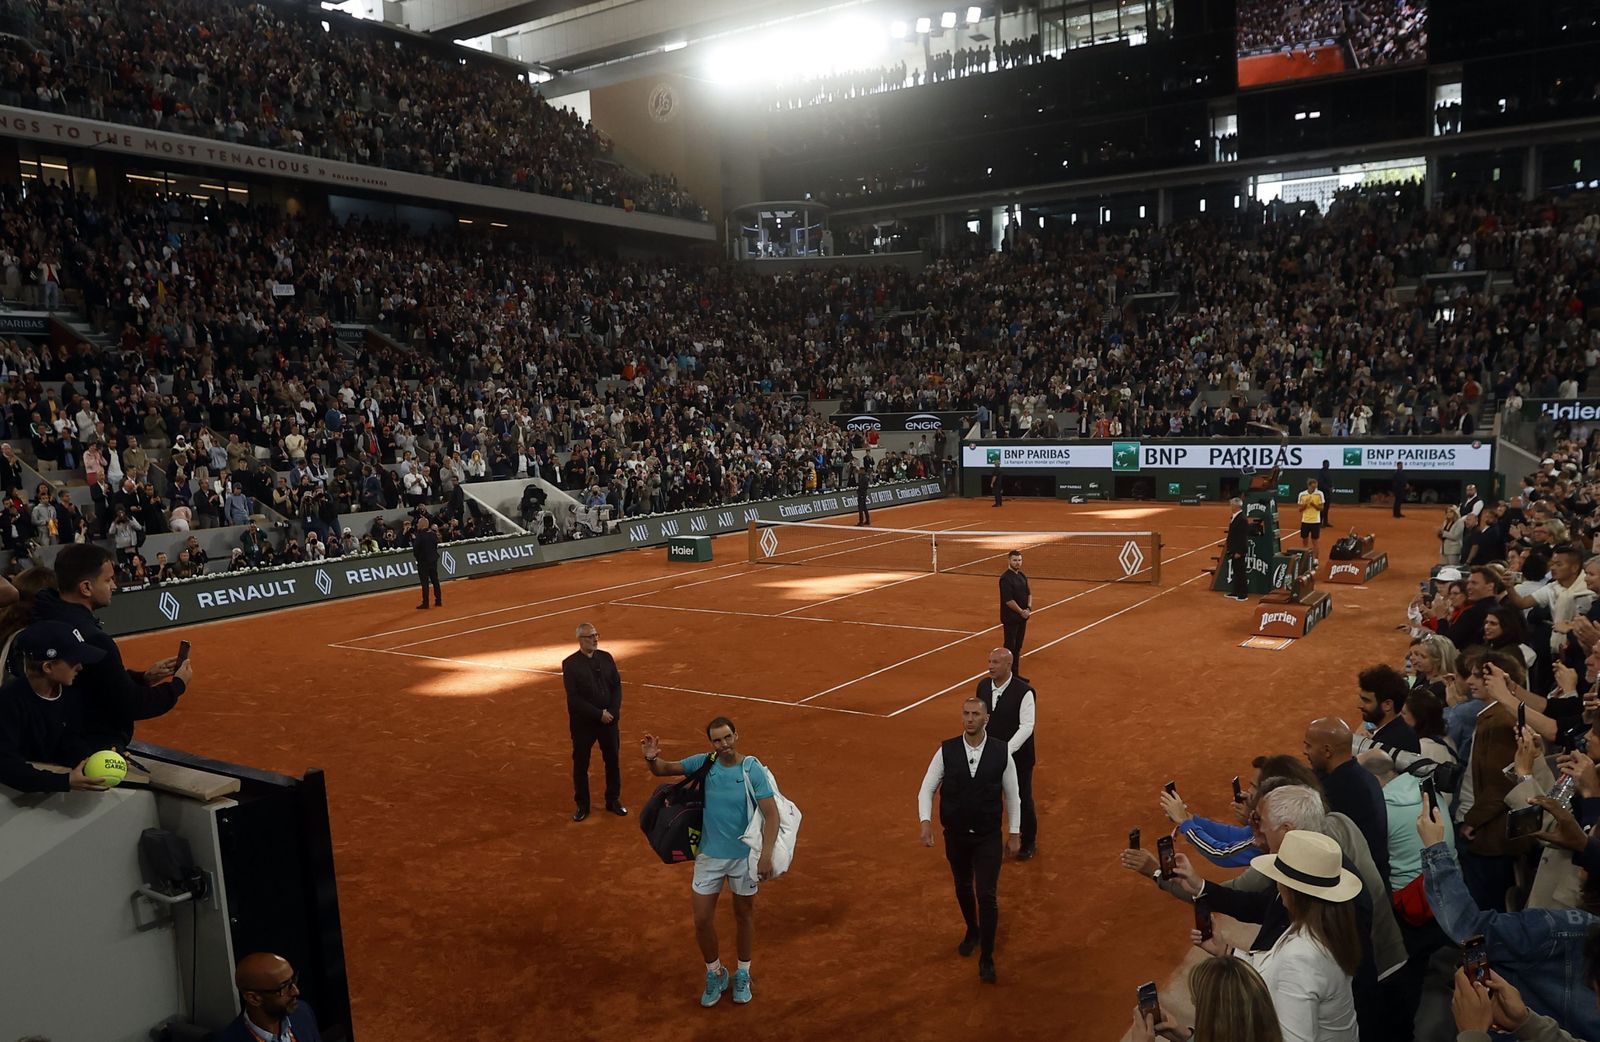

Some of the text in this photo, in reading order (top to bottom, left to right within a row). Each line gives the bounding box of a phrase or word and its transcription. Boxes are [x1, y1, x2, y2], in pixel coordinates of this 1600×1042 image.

[54, 124, 80, 139] TO
[93, 130, 132, 147] THE
[144, 139, 197, 157] MOST
[206, 149, 310, 174] TENACIOUS
[1004, 449, 1071, 459] BNP PARIBAS
[1145, 448, 1302, 466] BNP PARIBAS
[1367, 449, 1456, 460] BNP PARIBAS
[842, 495, 871, 508] Emirs
[896, 487, 921, 499] Emirates
[779, 503, 812, 517] Emirates
[821, 498, 838, 511] BETTER
[467, 544, 535, 566] RENAULT
[671, 545, 695, 555] Haier
[345, 561, 418, 585] RENAUL
[197, 579, 296, 609] RENAULT
